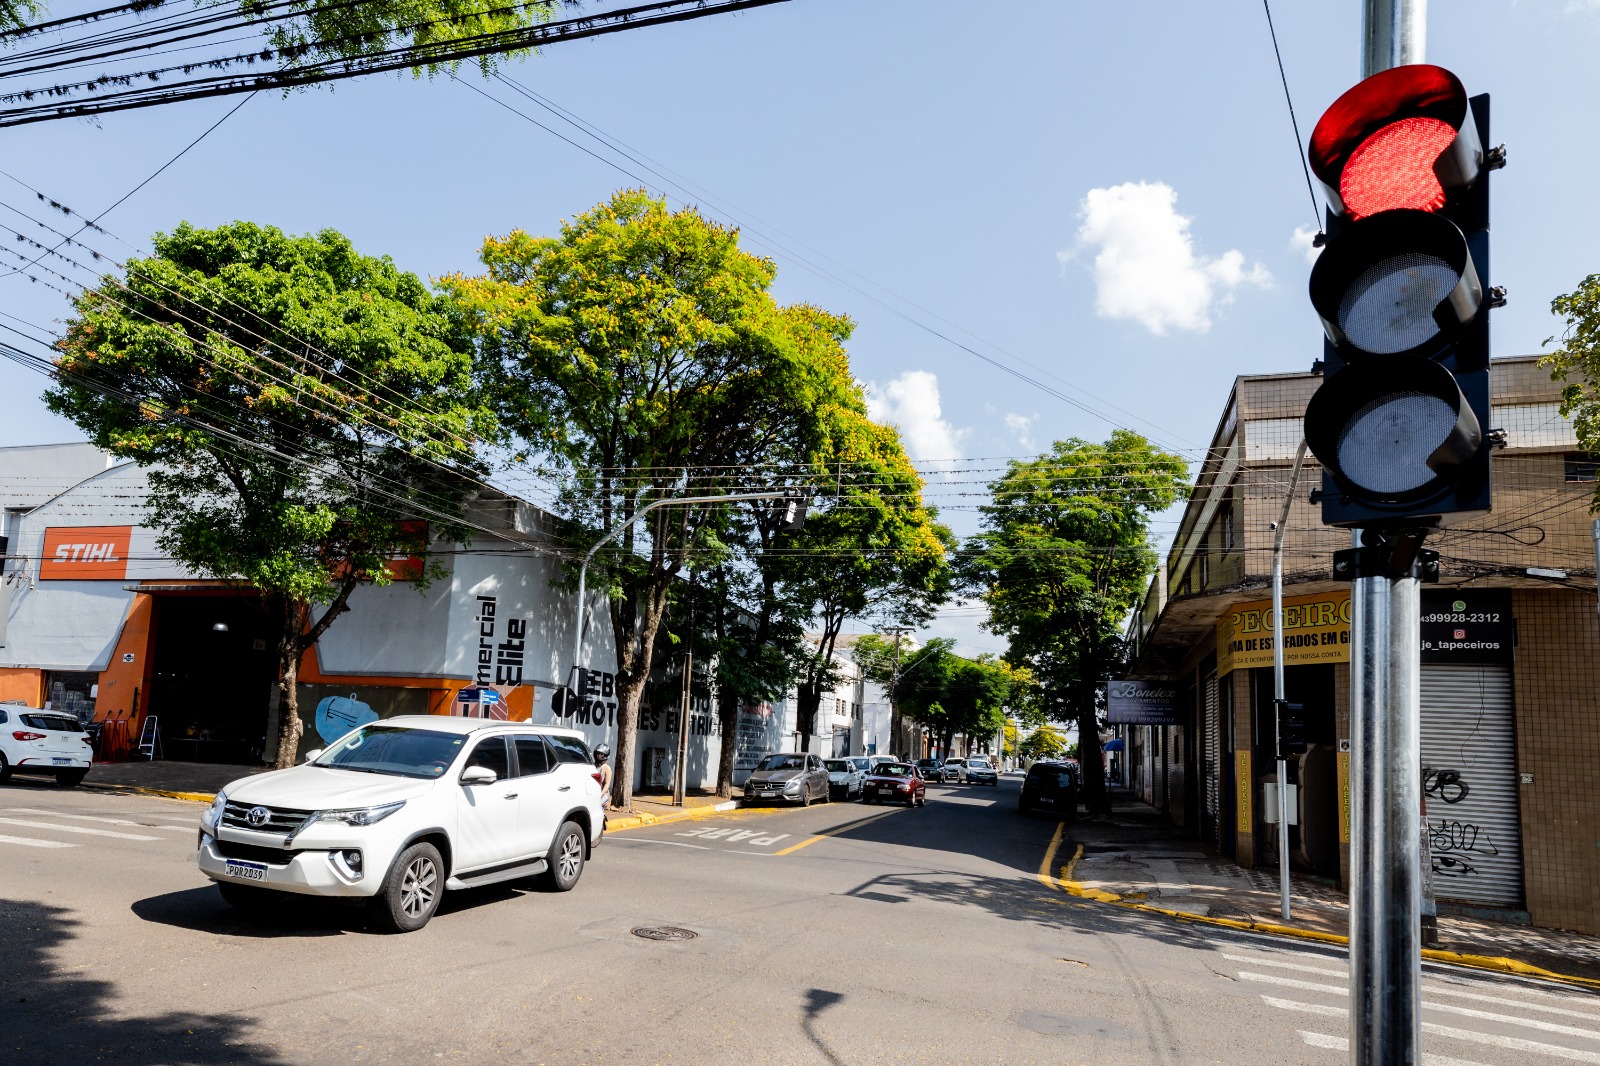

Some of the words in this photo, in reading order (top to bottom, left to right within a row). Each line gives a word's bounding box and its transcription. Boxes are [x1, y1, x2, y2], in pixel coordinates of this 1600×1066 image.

[52, 543, 119, 563] STIHL
[474, 595, 496, 688] mercial
[1246, 638, 1258, 651] DE
[1260, 633, 1319, 650] ESTFADOS
[1321, 631, 1338, 646] EM
[1421, 640, 1500, 651] je_tapeceiros
[496, 618, 526, 687] Elite
[1300, 652, 1320, 660] NOSSA
[576, 701, 660, 731] MOTES
[673, 827, 791, 846] PARE
